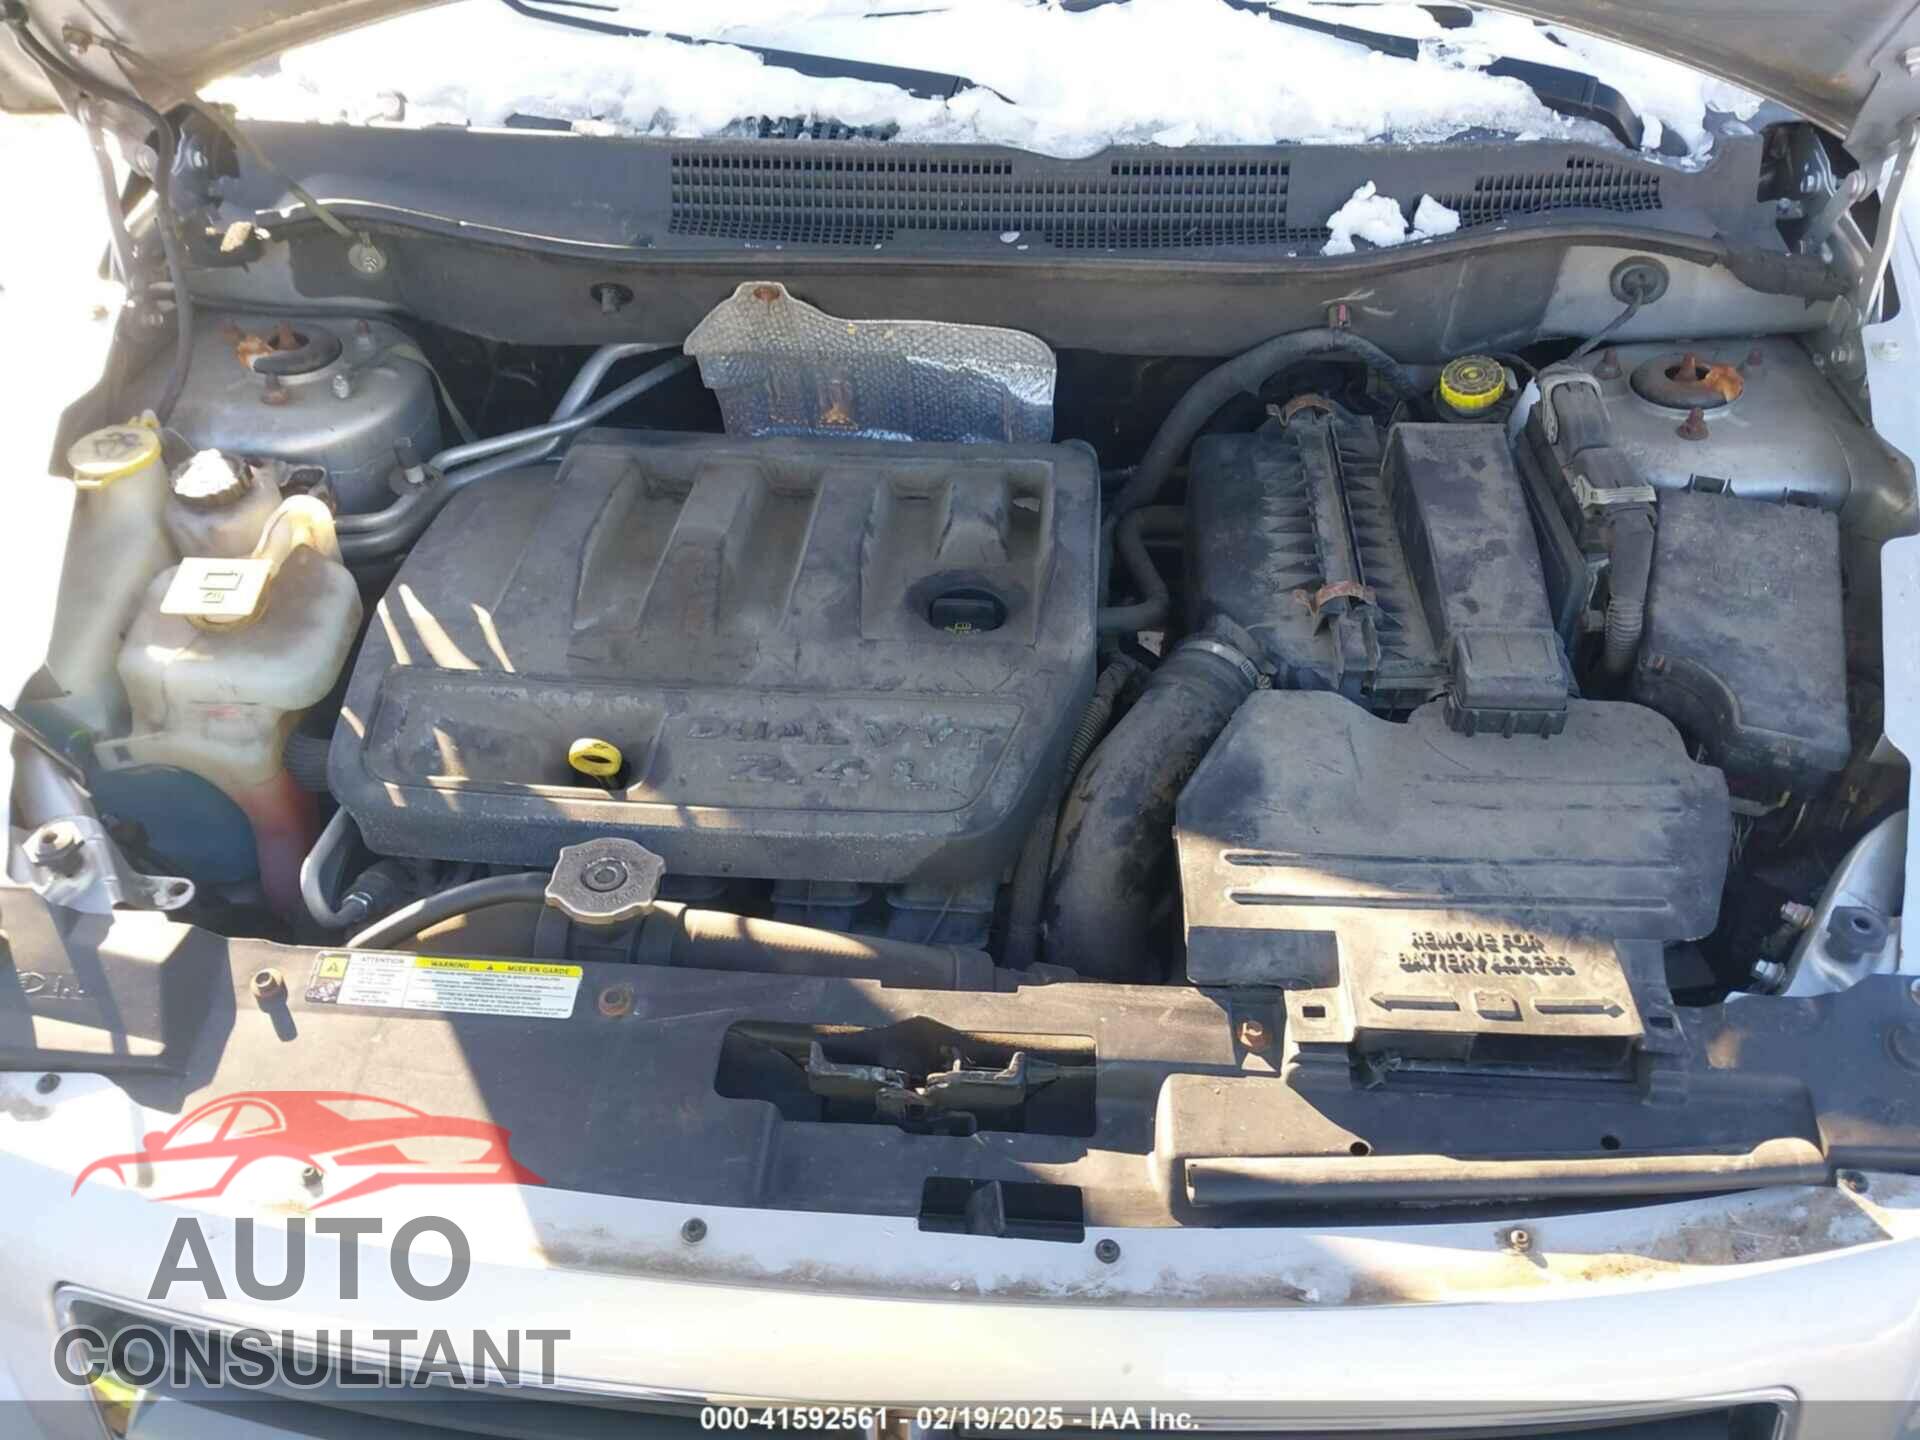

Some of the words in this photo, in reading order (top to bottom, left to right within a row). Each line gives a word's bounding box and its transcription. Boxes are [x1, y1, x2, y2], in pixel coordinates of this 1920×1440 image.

[687, 718, 850, 747] DUAL
[1411, 931, 1500, 953] REMOVE
[1502, 932, 1545, 954] FOR
[360, 956, 405, 965] ATTENTION
[431, 960, 470, 969] WARNING
[507, 965, 527, 973] MISE
[528, 966, 541, 974] EN
[542, 967, 570, 975] GARDE
[1398, 952, 1488, 974] BATTERY
[1490, 955, 1576, 976] ACCESS
